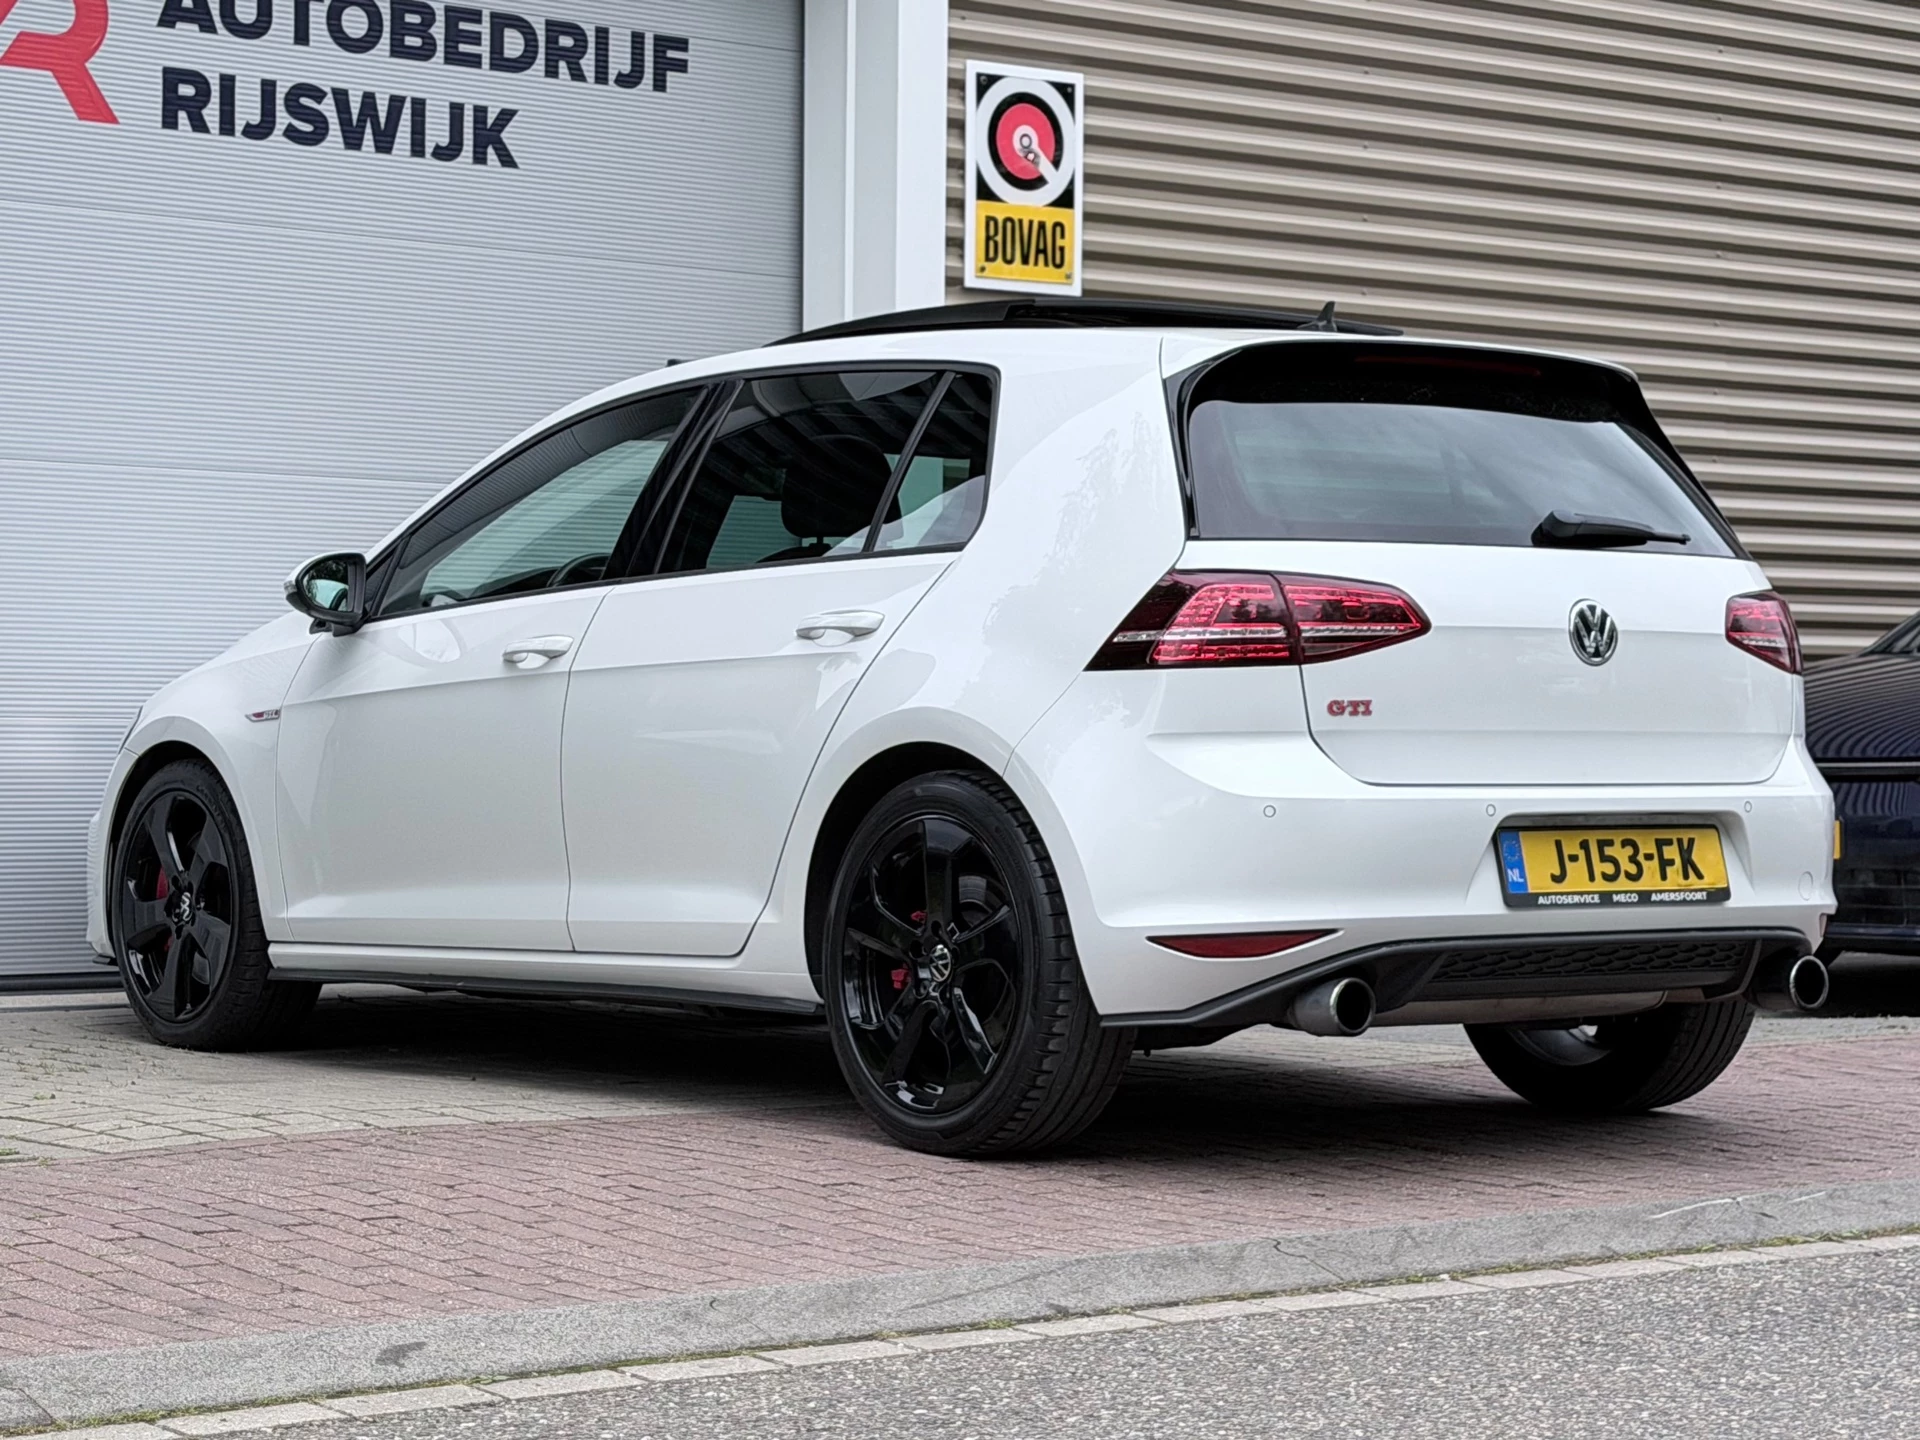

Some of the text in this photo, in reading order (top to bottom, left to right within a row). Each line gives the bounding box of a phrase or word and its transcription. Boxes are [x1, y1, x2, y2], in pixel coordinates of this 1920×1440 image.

[160, 66, 520, 169] RIJSWIJK
[984, 215, 1066, 270] BOVAG
[1326, 699, 1373, 717] GTI
[1507, 837, 1705, 884] NL J-153-FK
[1537, 891, 1708, 905] AUTOSERVICE MECO AMERSFOORT
